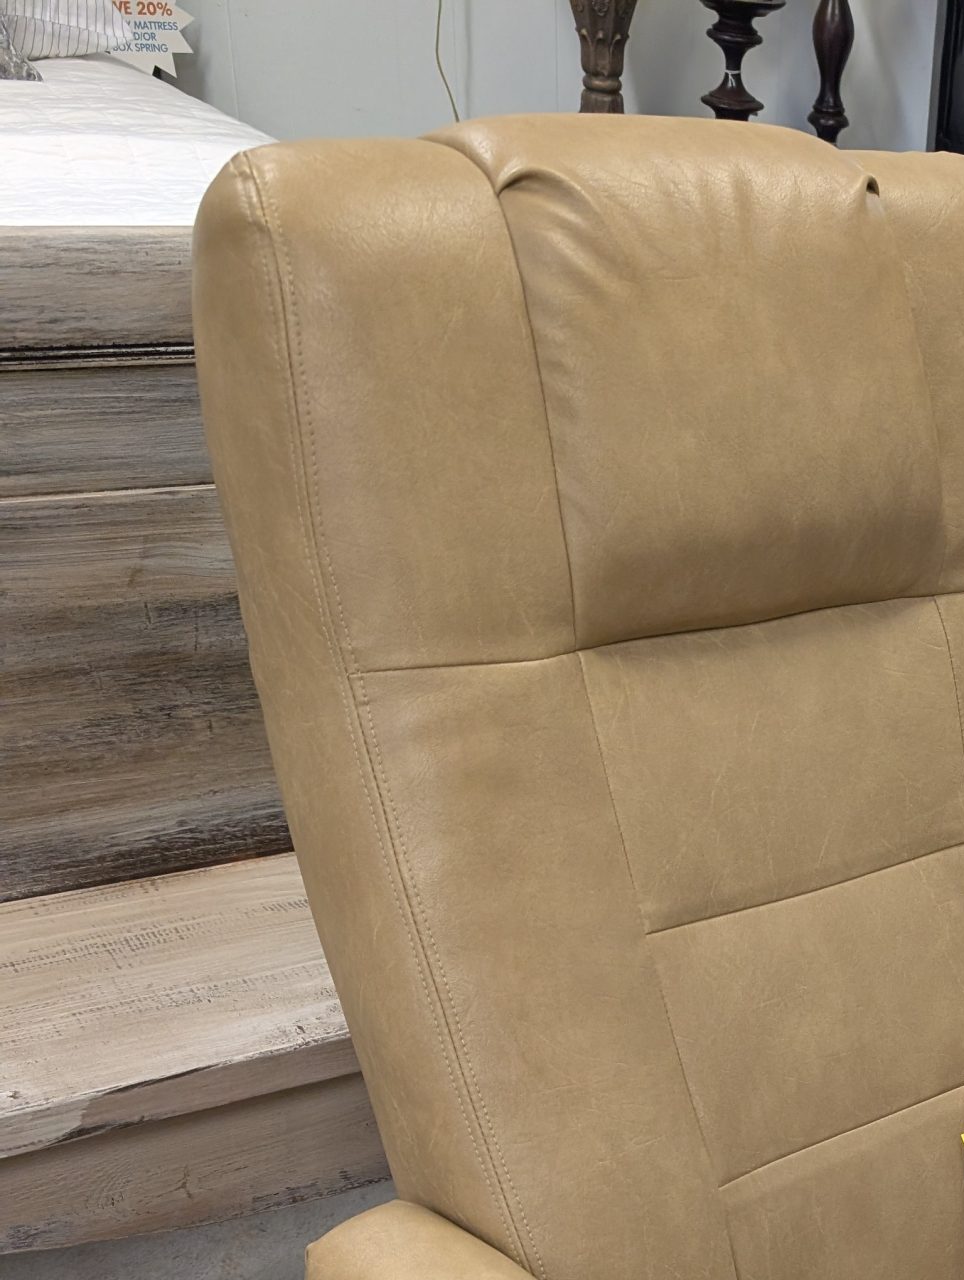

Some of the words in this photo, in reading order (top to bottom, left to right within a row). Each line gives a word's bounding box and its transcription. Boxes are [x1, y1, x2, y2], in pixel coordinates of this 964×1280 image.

[112, 0, 132, 15] VE
[137, 1, 173, 16] 20%
[134, 21, 179, 31] MATTRESS
[135, 43, 169, 52] SPRING
